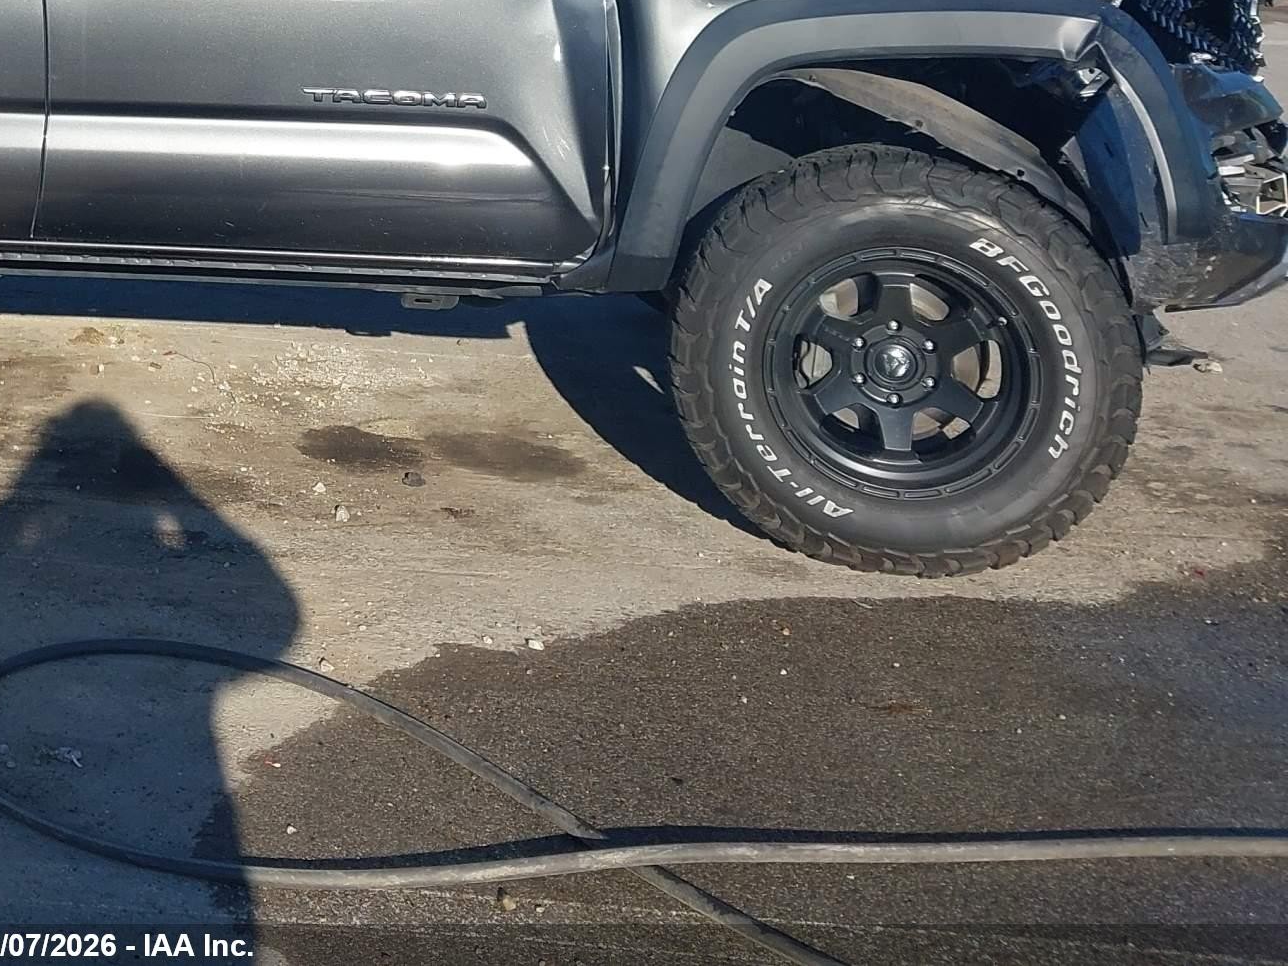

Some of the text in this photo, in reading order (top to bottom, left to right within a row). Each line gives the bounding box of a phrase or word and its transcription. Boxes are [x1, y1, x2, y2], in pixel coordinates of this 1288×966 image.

[302, 86, 487, 109] TACOMA
[729, 277, 854, 520] All-Terrain T/A
[968, 237, 1083, 460] BFGoodrich
